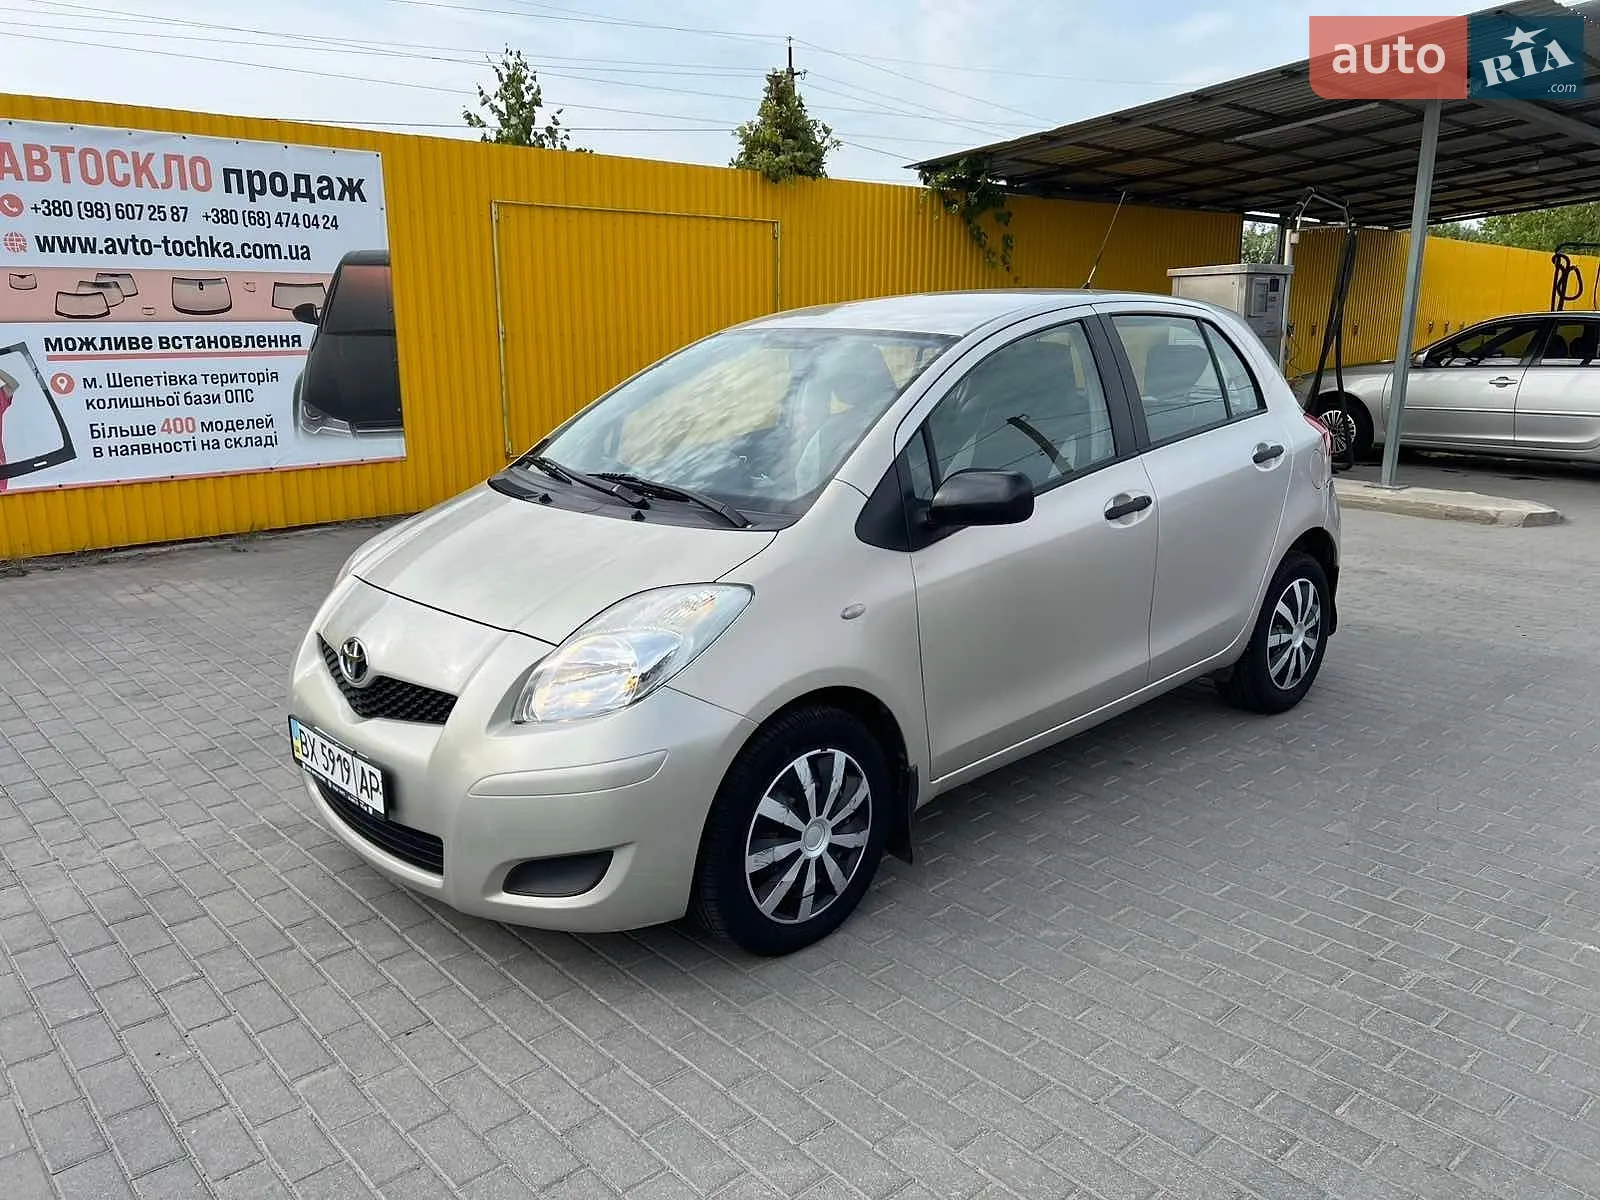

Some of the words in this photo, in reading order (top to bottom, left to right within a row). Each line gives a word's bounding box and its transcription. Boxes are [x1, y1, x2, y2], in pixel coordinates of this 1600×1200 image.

[0, 141, 213, 193] АВТОСКЛО
[222, 168, 367, 204] продаж
[30, 200, 73, 217] +380
[77, 201, 111, 221] (98)
[115, 203, 144, 220] 607
[148, 205, 167, 221] 25
[170, 206, 189, 222] 87
[202, 208, 239, 225] +380
[242, 210, 272, 229] (68)
[275, 212, 300, 228] 474
[302, 213, 320, 229] 04
[322, 215, 339, 230] 24
[35, 234, 312, 261] www.avto-tochka.com.ua
[44, 335, 153, 352] можливе
[158, 334, 301, 350] встановлення
[83, 376, 103, 389] м.
[106, 371, 197, 388] Шепетівка
[200, 368, 279, 385] територія
[86, 392, 180, 410] колишньої
[184, 391, 221, 406] бази
[225, 388, 254, 404] ОПС
[89, 422, 157, 440] Більше
[160, 416, 197, 435] 400
[200, 414, 274, 432] моделей
[93, 444, 103, 458] в
[108, 436, 197, 457] наявності
[201, 439, 220, 451] на
[224, 431, 278, 449] складі
